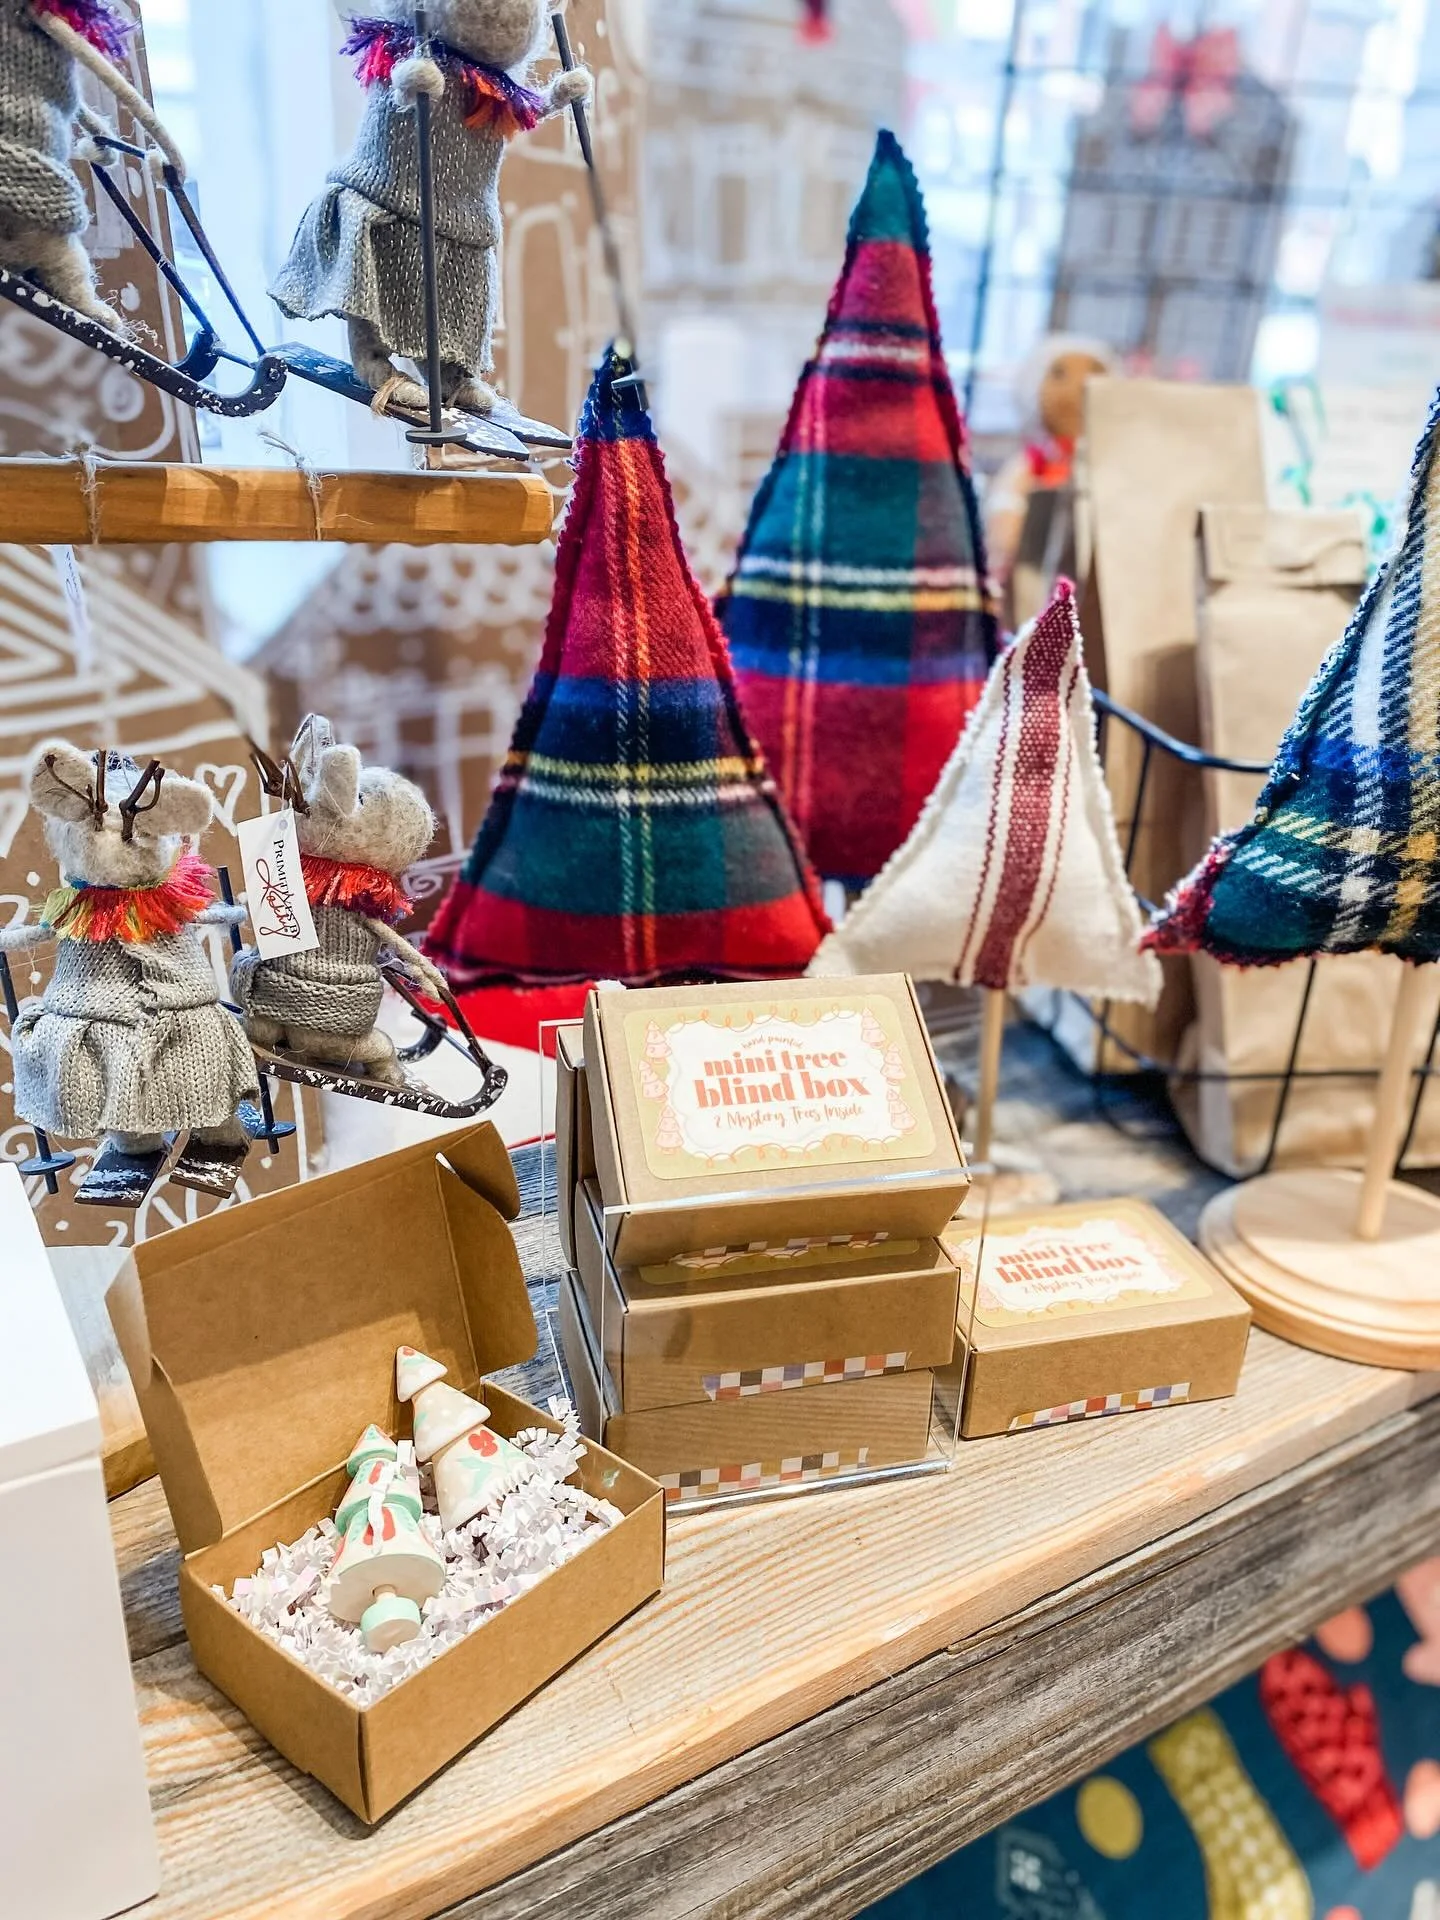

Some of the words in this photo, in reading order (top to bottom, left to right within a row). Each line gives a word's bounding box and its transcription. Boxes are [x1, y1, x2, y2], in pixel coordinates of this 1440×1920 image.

[273, 839, 295, 921] PRIMITIVES
[256, 858, 301, 939] Kathy
[741, 1035, 766, 1050] hand
[767, 1035, 805, 1049] painted
[703, 1049, 776, 1076] mini
[780, 1050, 848, 1071] tree
[694, 1072, 796, 1109] blind
[800, 1071, 871, 1099] box
[727, 1110, 787, 1130] Mystery
[790, 1105, 821, 1124] Trees
[823, 1103, 864, 1121] Inside
[999, 1244, 1059, 1265] mini
[1059, 1241, 1113, 1256] tree
[995, 1257, 1083, 1284] blind
[1081, 1255, 1143, 1272] box
